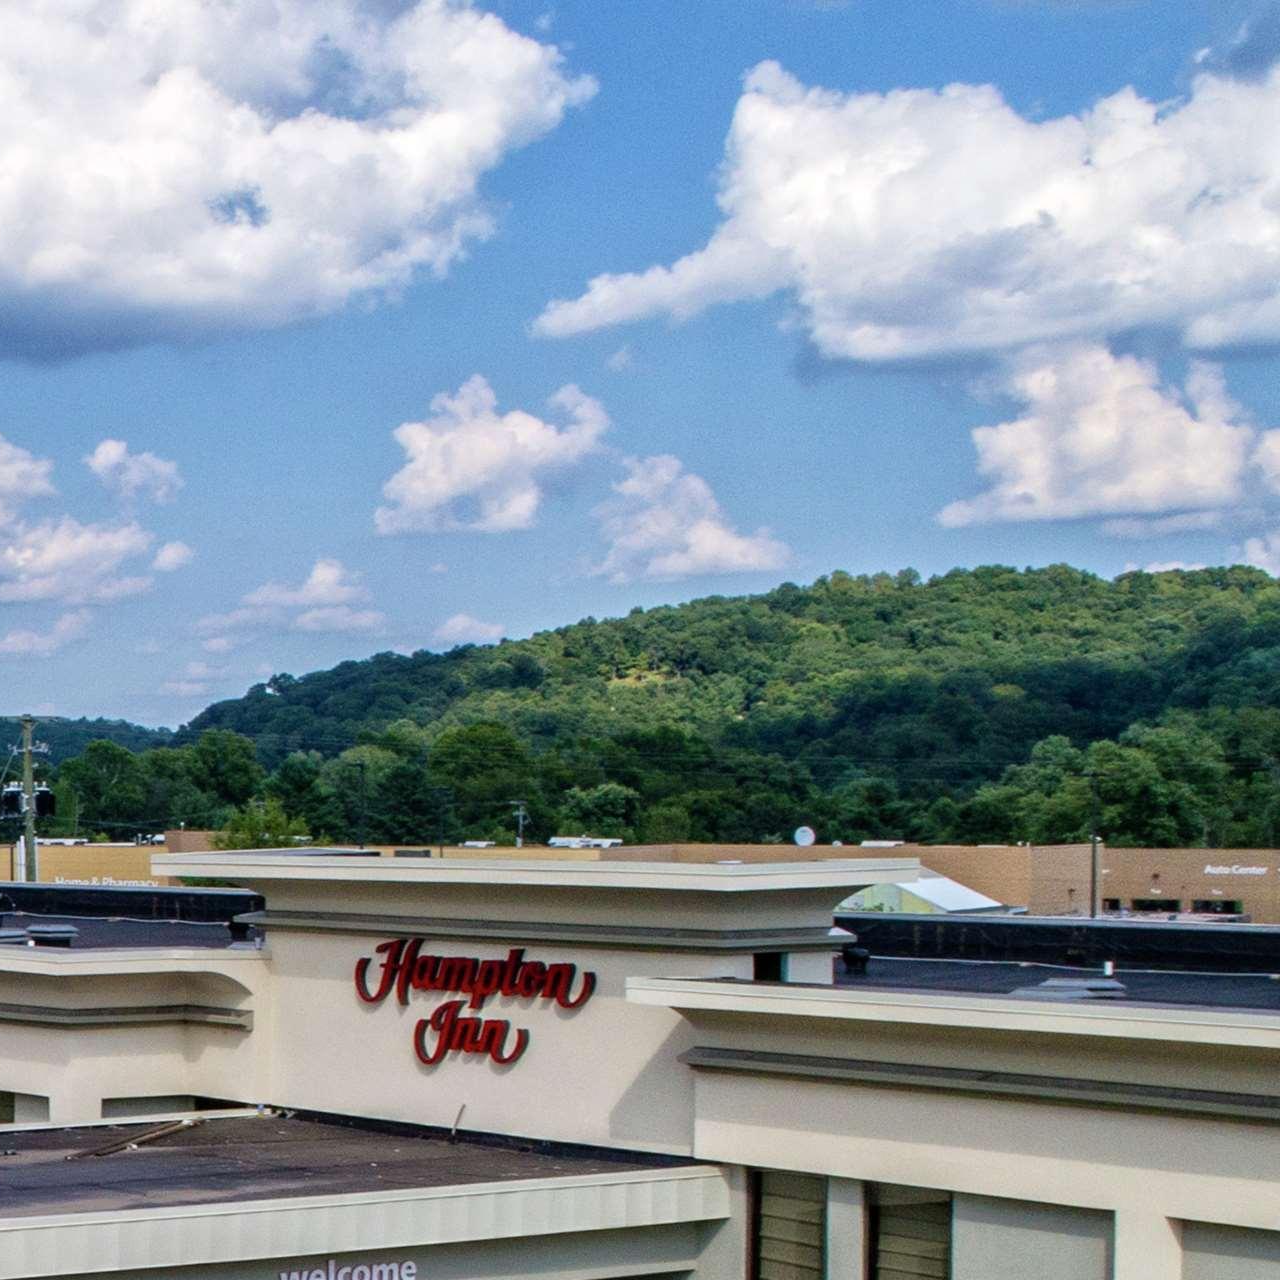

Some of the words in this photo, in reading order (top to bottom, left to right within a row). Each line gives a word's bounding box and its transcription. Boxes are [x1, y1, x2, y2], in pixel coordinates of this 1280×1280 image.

[1204, 865, 1230, 875] Auto
[1232, 865, 1268, 875] Center
[354, 938, 597, 1009] Hampton
[414, 1000, 530, 1065] Inn
